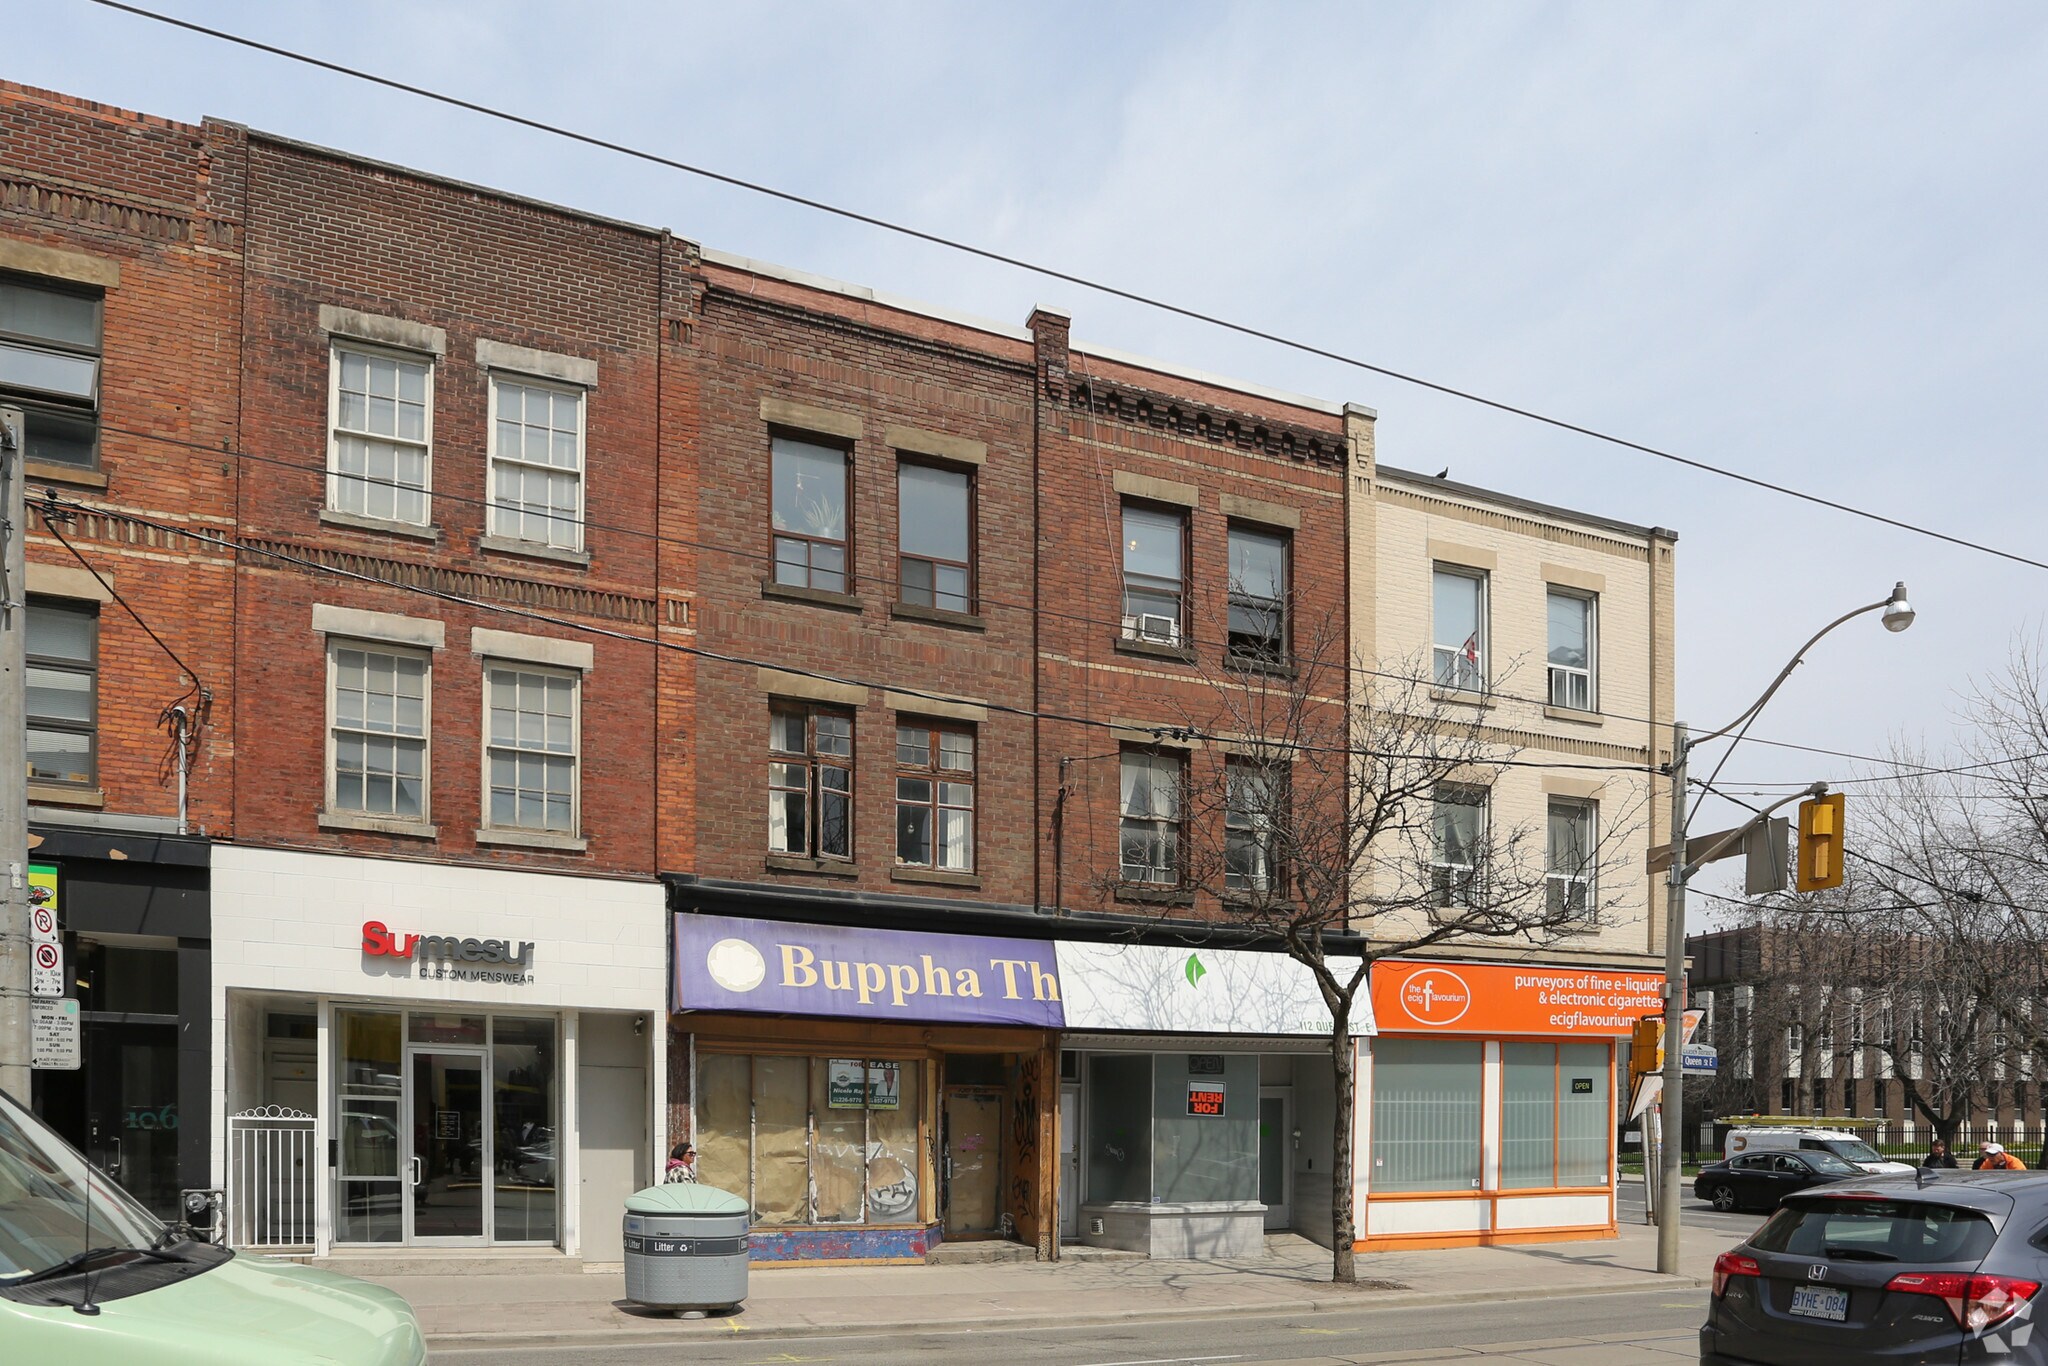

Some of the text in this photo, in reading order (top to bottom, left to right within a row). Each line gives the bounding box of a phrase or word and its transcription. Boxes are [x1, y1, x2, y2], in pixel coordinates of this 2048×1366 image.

[362, 921, 535, 965] Surmesur
[419, 967, 534, 985] CUSTOM MENSWEAR
[775, 943, 983, 1007] Buppha
[1515, 975, 1574, 990] purveyors
[1577, 975, 1589, 989] of
[1590, 976, 1612, 990] fine
[1409, 984, 1421, 993] the
[1408, 993, 1423, 1004] ecig
[1538, 990, 1663, 1010] & electronic cigarettes
[1549, 1011, 1662, 1029] ecigflavouriumm
[1300, 1021, 1313, 1031] 112
[1316, 1021, 1334, 1032] QUE
[1365, 1023, 1371, 1032] E
[869, 1061, 899, 1069] EASE
[1190, 1056, 1223, 1070] OPEN
[1685, 1056, 1702, 1066] Queen
[1575, 1082, 1590, 1090] OPEN
[1189, 1092, 1223, 1104] RENT
[1194, 1103, 1219, 1114] FOR
[629, 1238, 641, 1249] Litter
[654, 1241, 675, 1252] Litter
